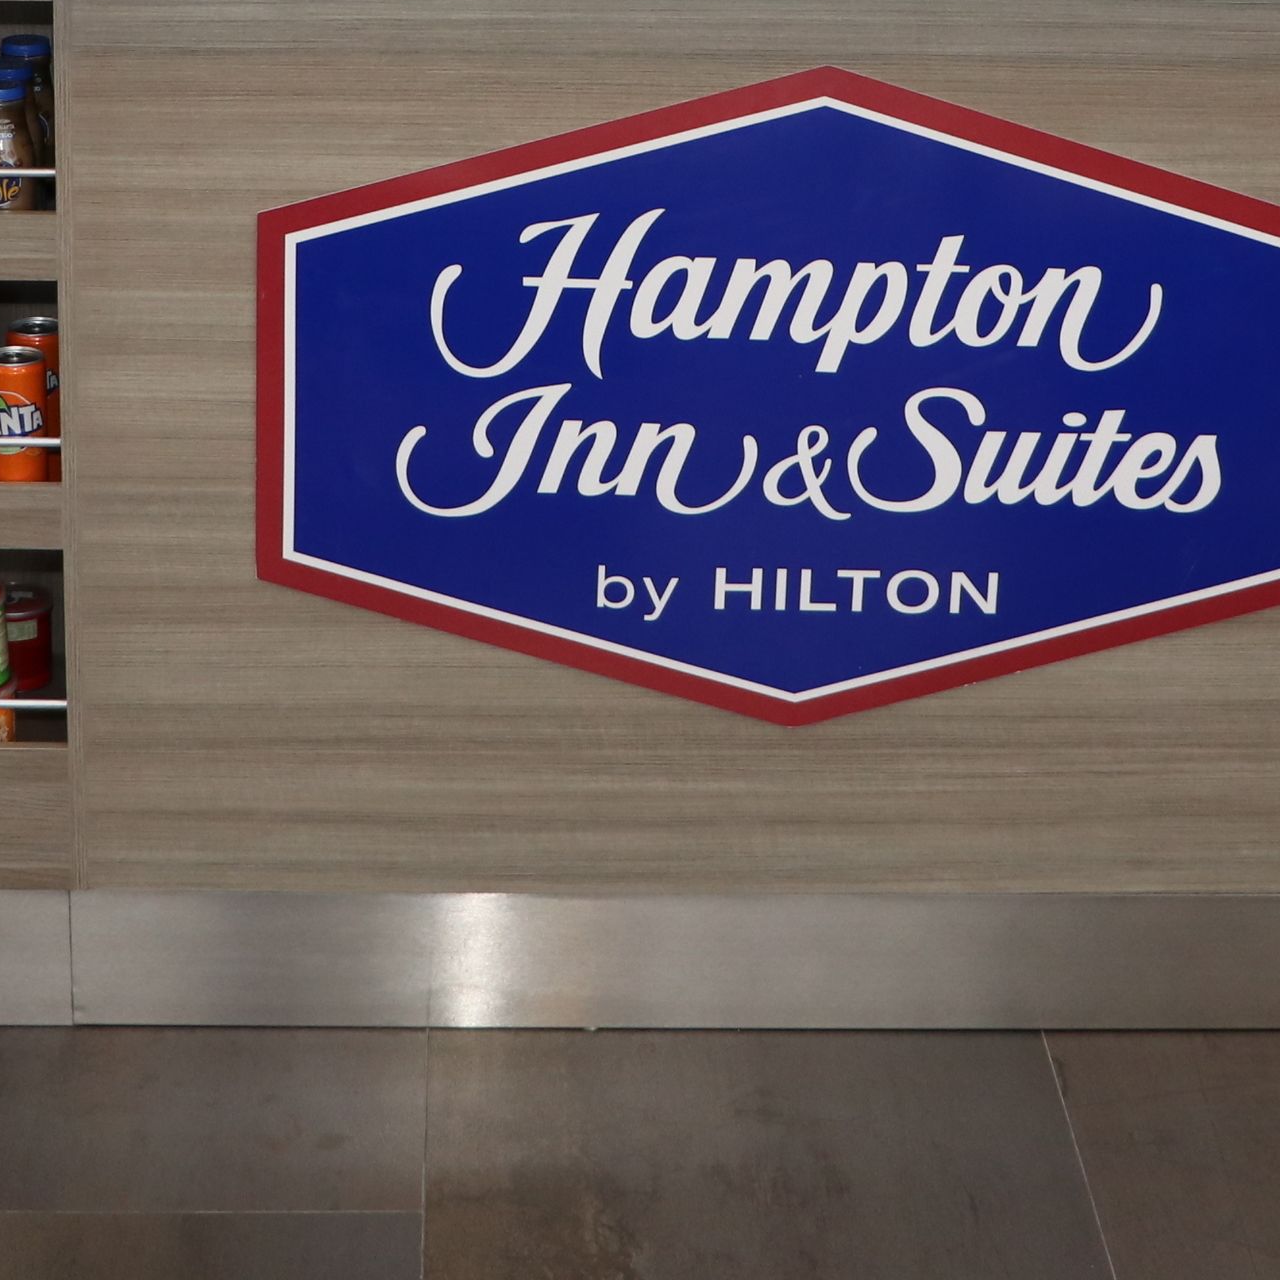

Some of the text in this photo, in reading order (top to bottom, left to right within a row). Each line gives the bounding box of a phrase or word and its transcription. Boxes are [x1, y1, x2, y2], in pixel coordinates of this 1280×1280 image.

[430, 208, 1162, 380] Hampton
[396, 383, 1221, 520] Inn & Suites
[596, 566, 1000, 622] by HILTON
